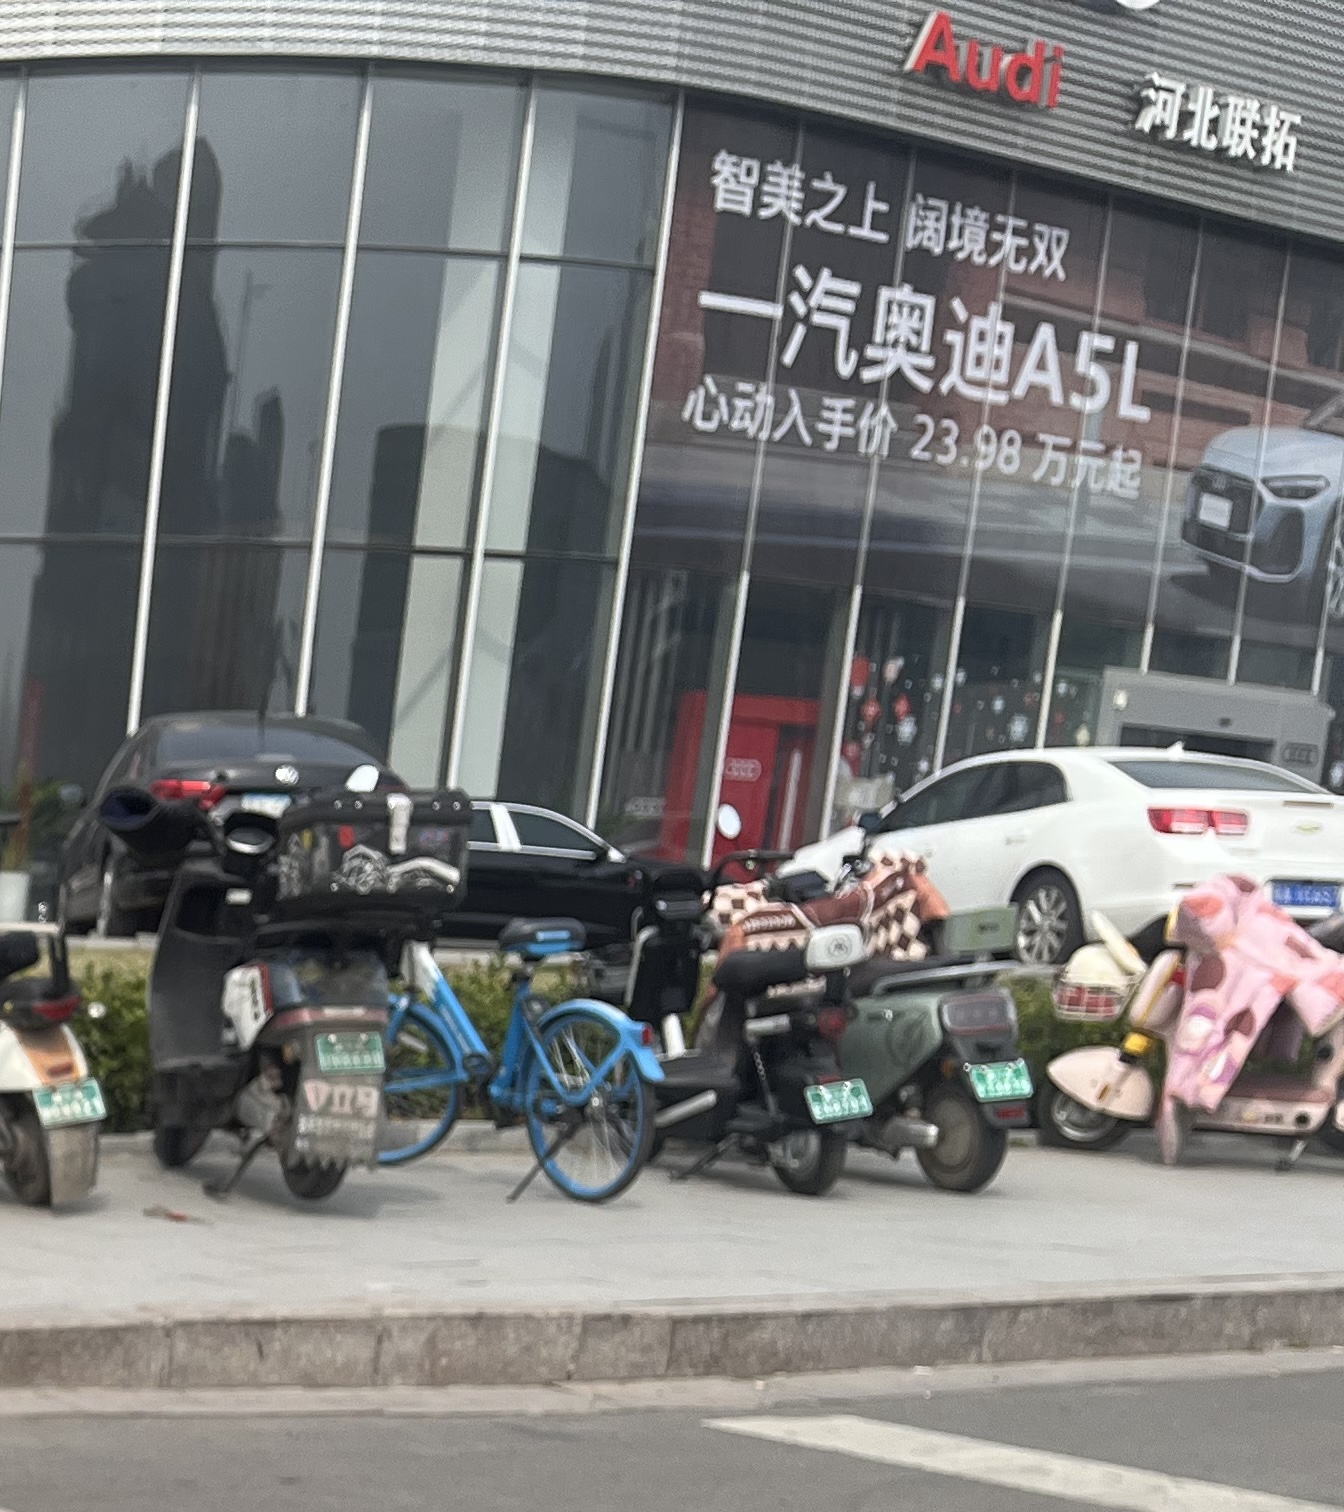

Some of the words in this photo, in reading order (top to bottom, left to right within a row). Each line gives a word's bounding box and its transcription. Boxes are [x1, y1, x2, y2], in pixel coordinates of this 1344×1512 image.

[904, 10, 1064, 109] Audi
[1135, 71, 1302, 173] 河北联拓
[711, 149, 890, 245] 智美之上
[905, 193, 1071, 281] 阔境无双
[697, 264, 1151, 423] 一汽奥迪A5L
[681, 374, 899, 459] 心动入手价
[910, 412, 1023, 475] 23.98
[1031, 432, 1143, 500] 万元起
